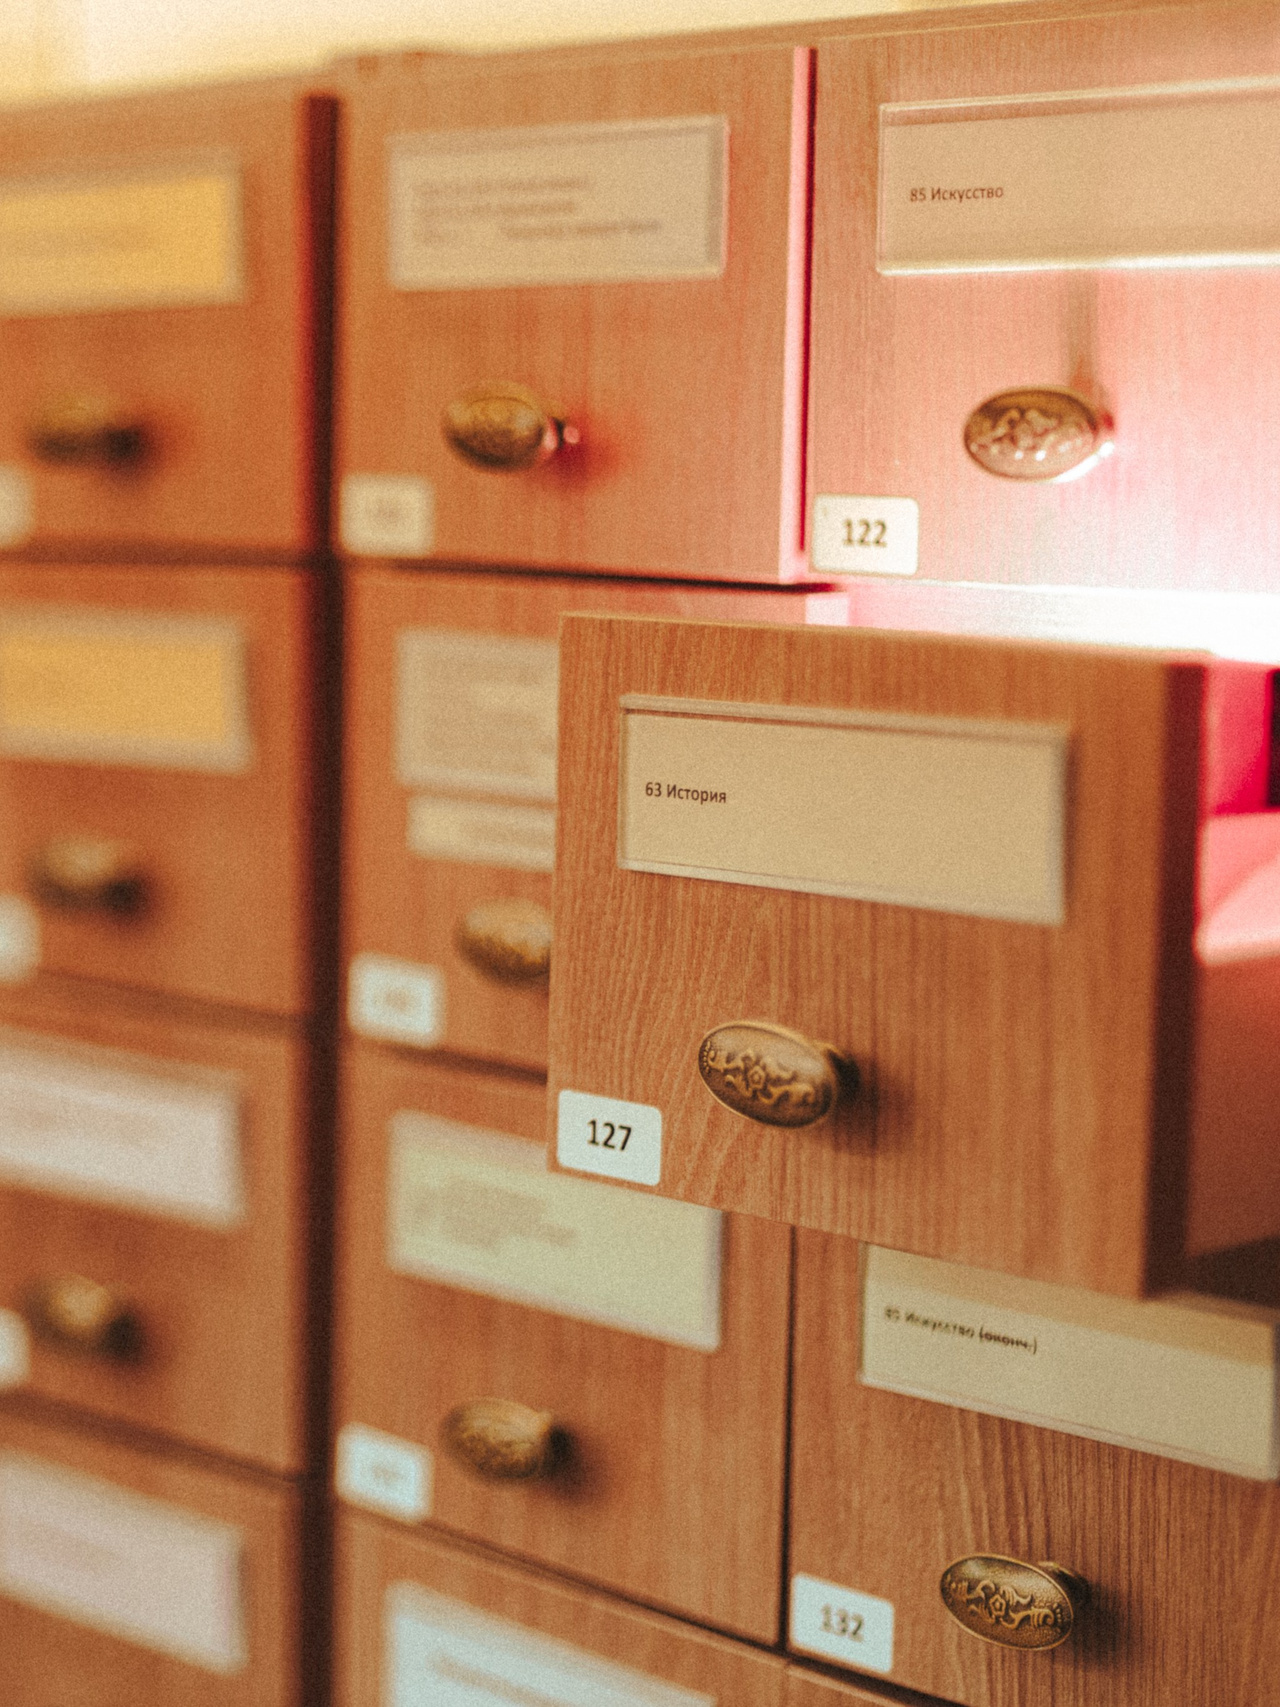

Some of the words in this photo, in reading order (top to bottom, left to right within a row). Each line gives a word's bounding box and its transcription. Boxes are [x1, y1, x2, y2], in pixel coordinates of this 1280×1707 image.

[909, 186, 927, 202] 85
[930, 186, 1004, 203] Искусство
[842, 518, 887, 548] 122
[645, 781, 662, 798] 63
[666, 783, 727, 805] История
[586, 1118, 632, 1151] 127
[821, 1604, 865, 1643] 132
